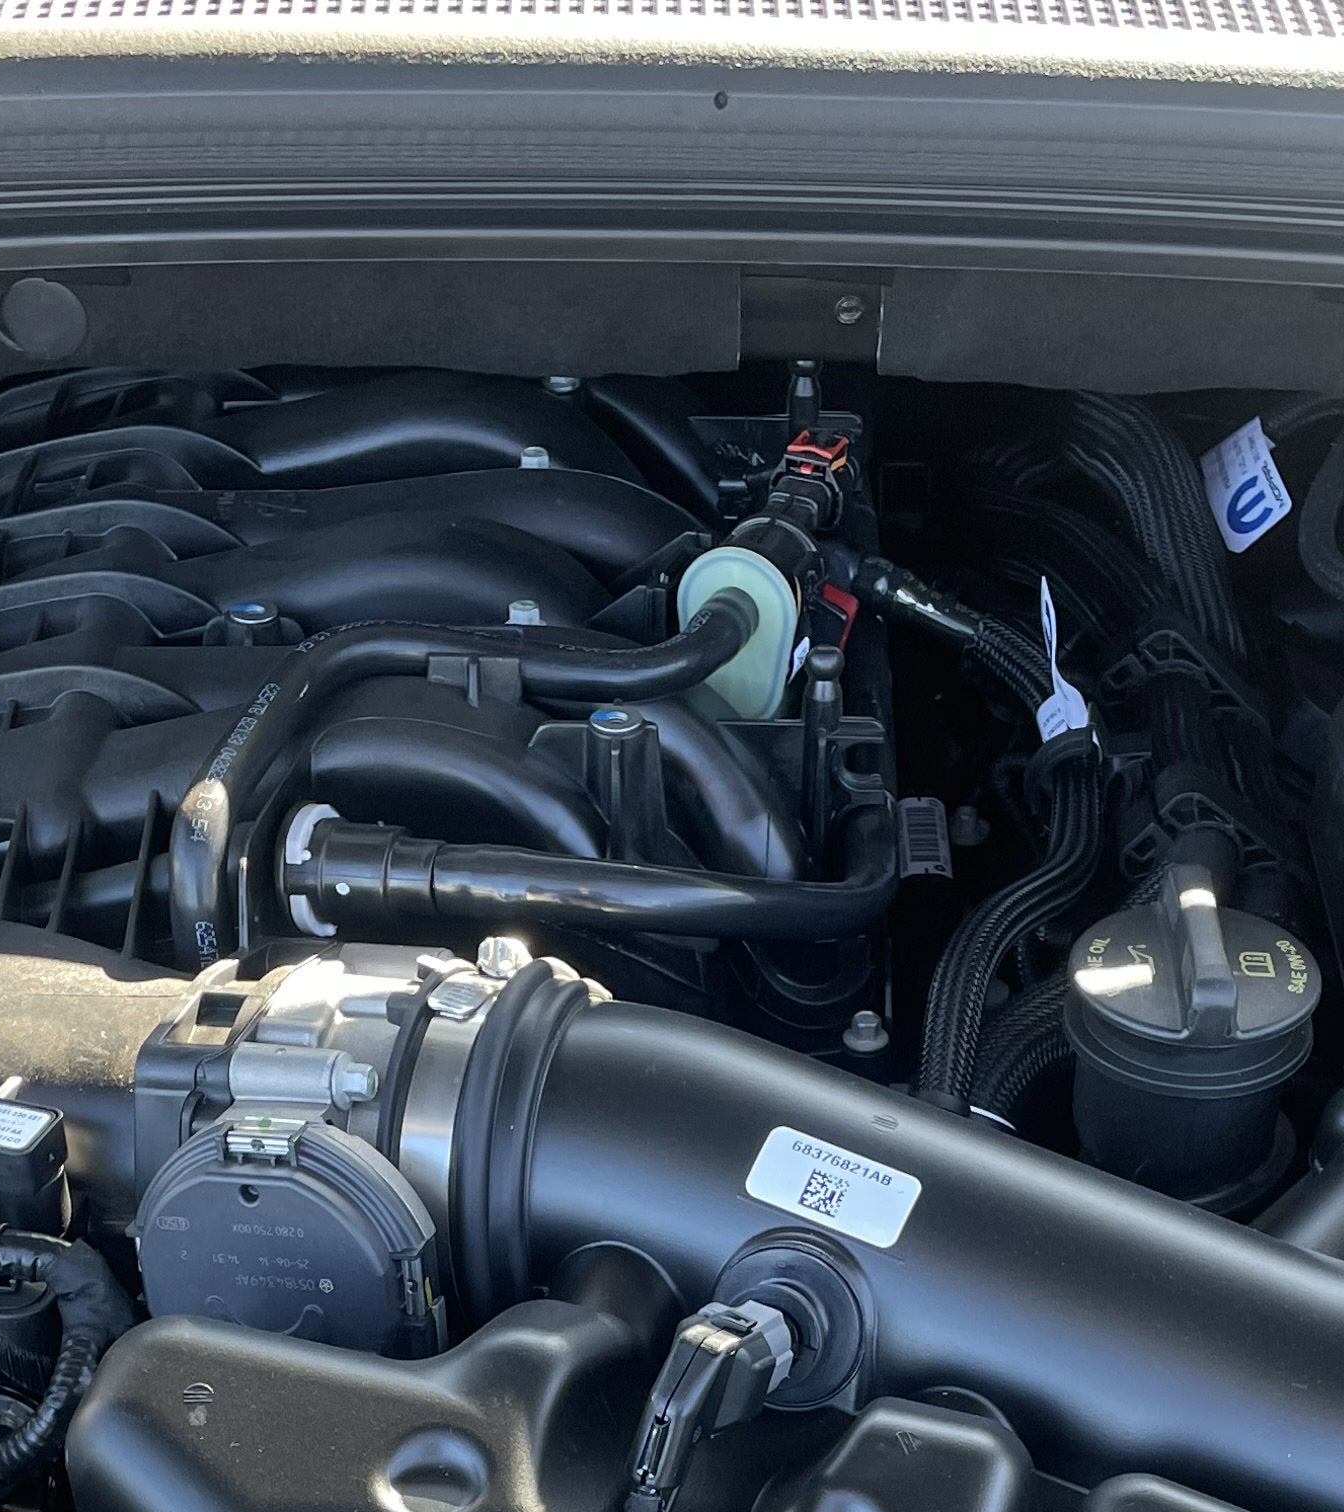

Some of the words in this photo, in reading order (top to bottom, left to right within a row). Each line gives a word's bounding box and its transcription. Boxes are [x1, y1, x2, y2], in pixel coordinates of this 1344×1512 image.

[1095, 937, 1112, 955] OIL
[1287, 970, 1308, 995] SAE
[791, 1139, 893, 1187] 68376821AB
